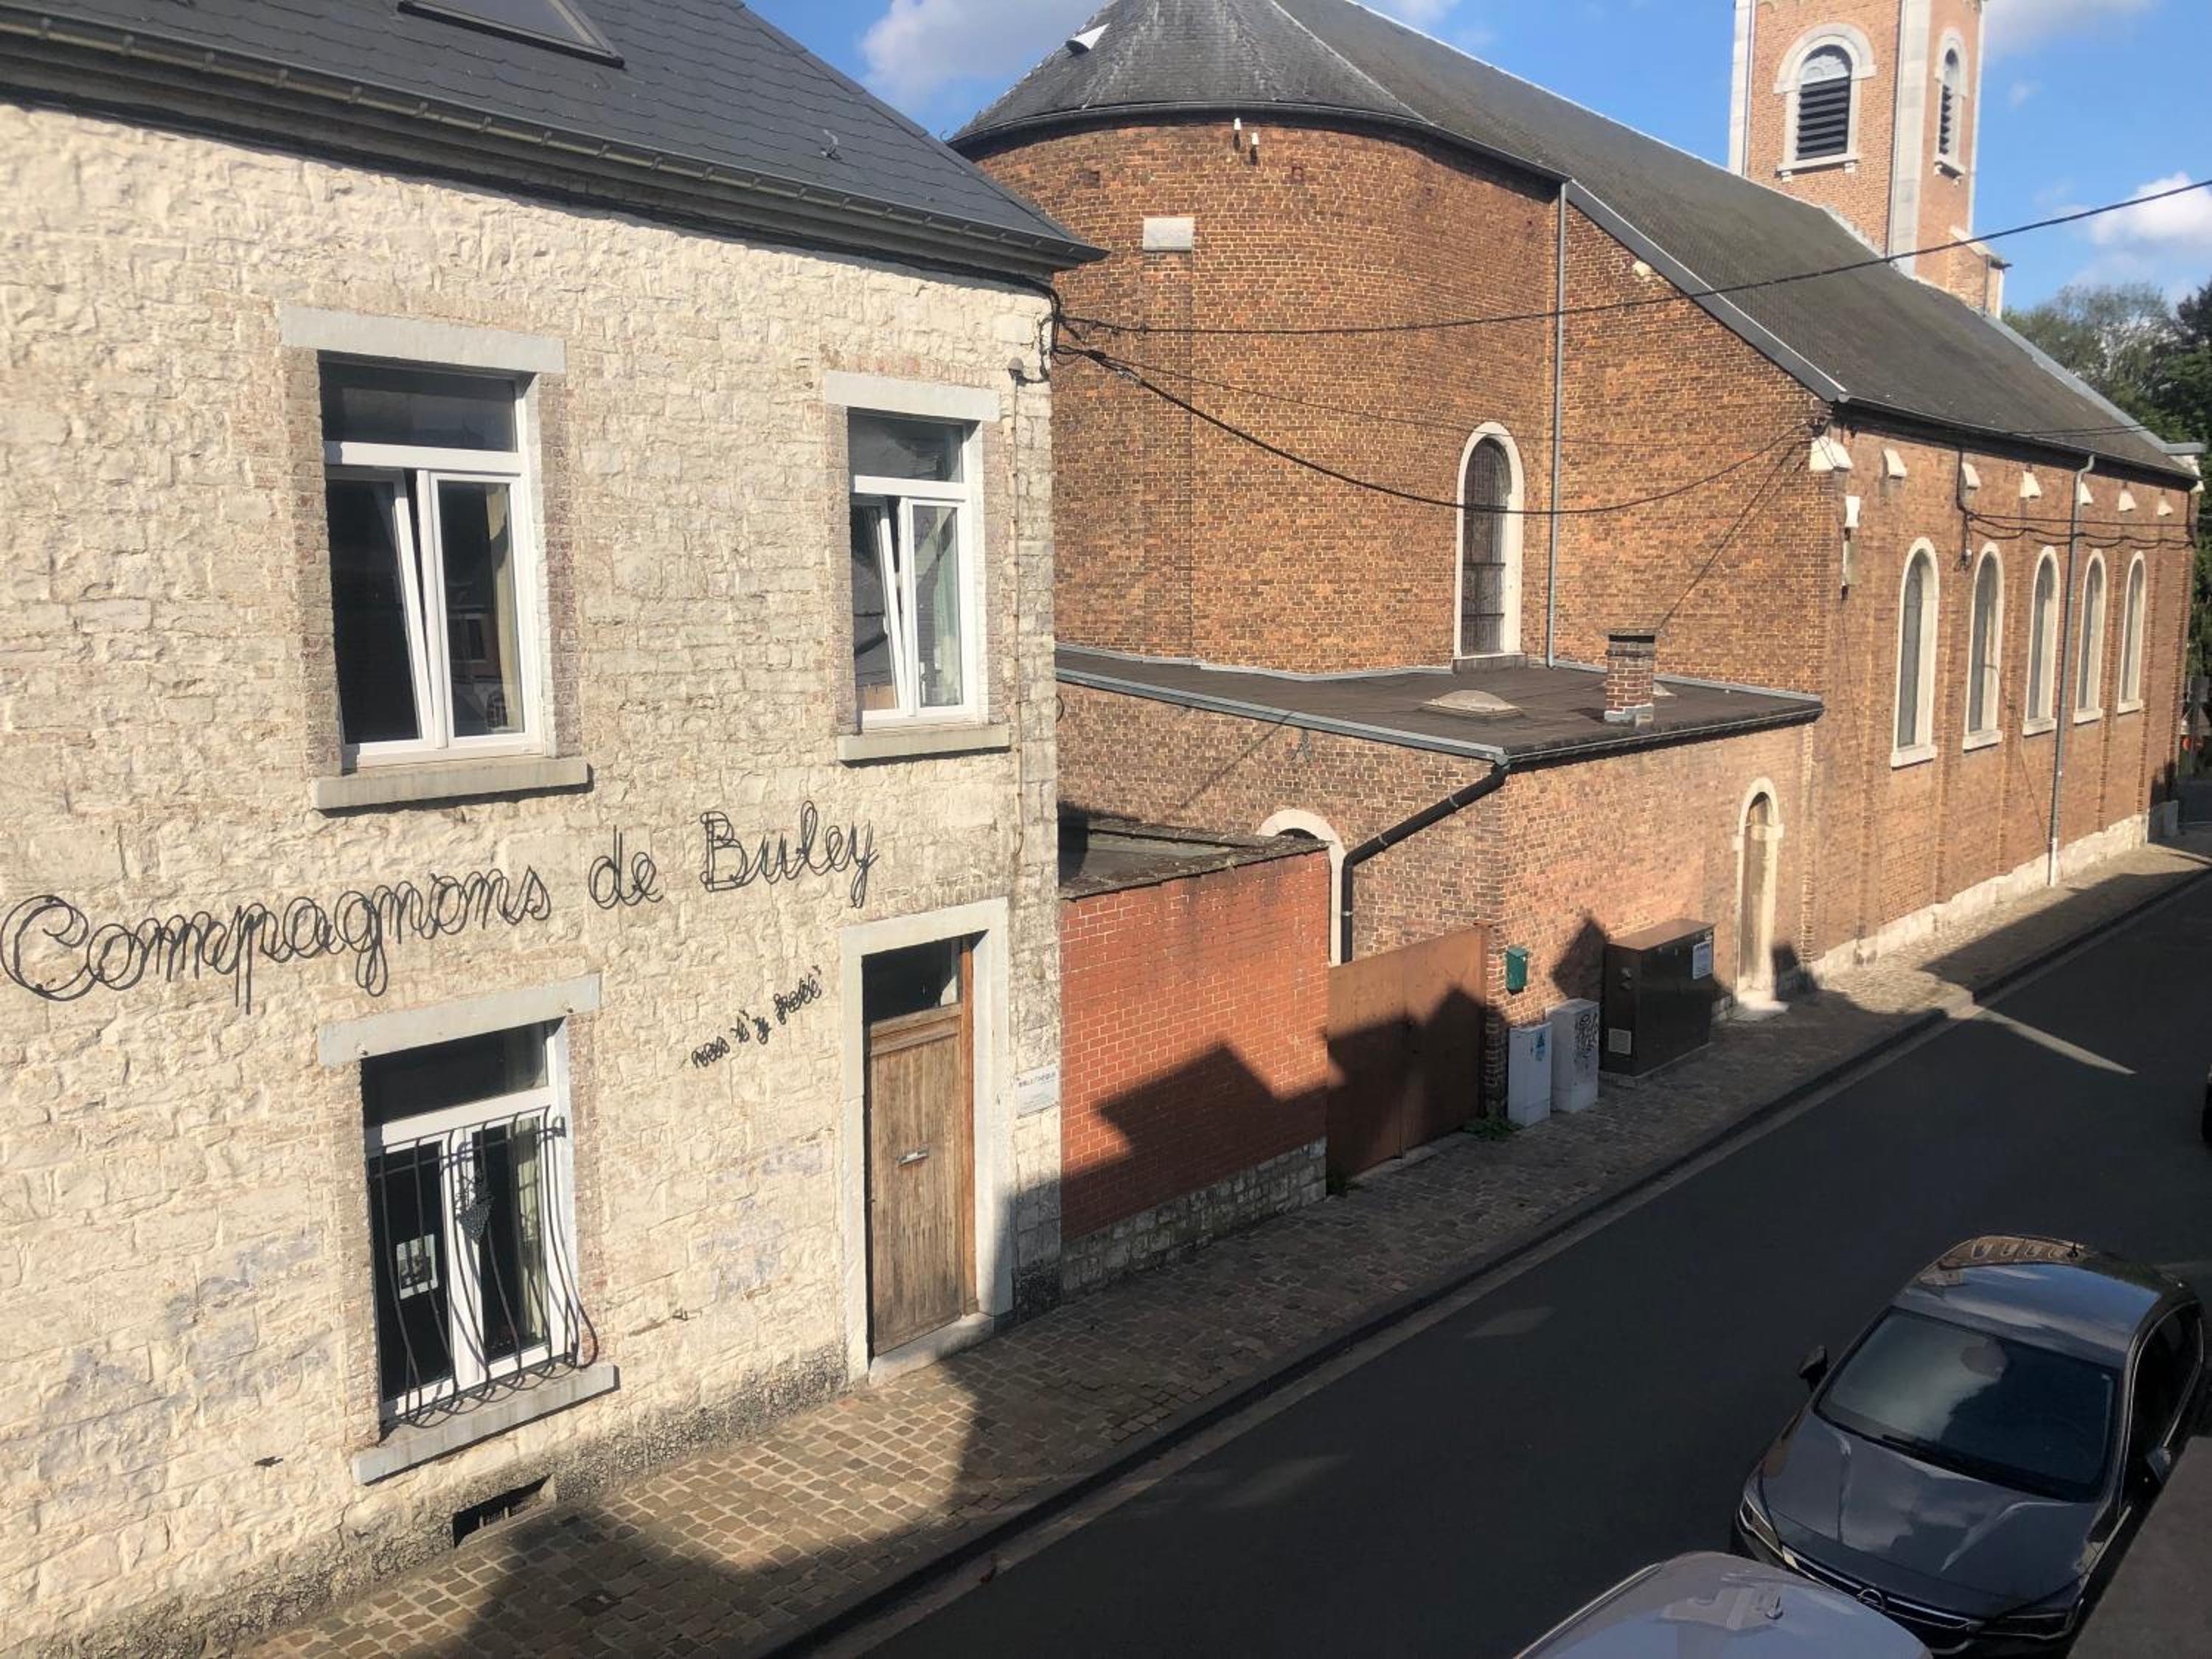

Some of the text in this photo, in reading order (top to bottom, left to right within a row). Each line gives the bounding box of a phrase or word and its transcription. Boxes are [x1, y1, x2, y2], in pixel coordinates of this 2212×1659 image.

[0, 800, 880, 1015] Compagnons de Buley
